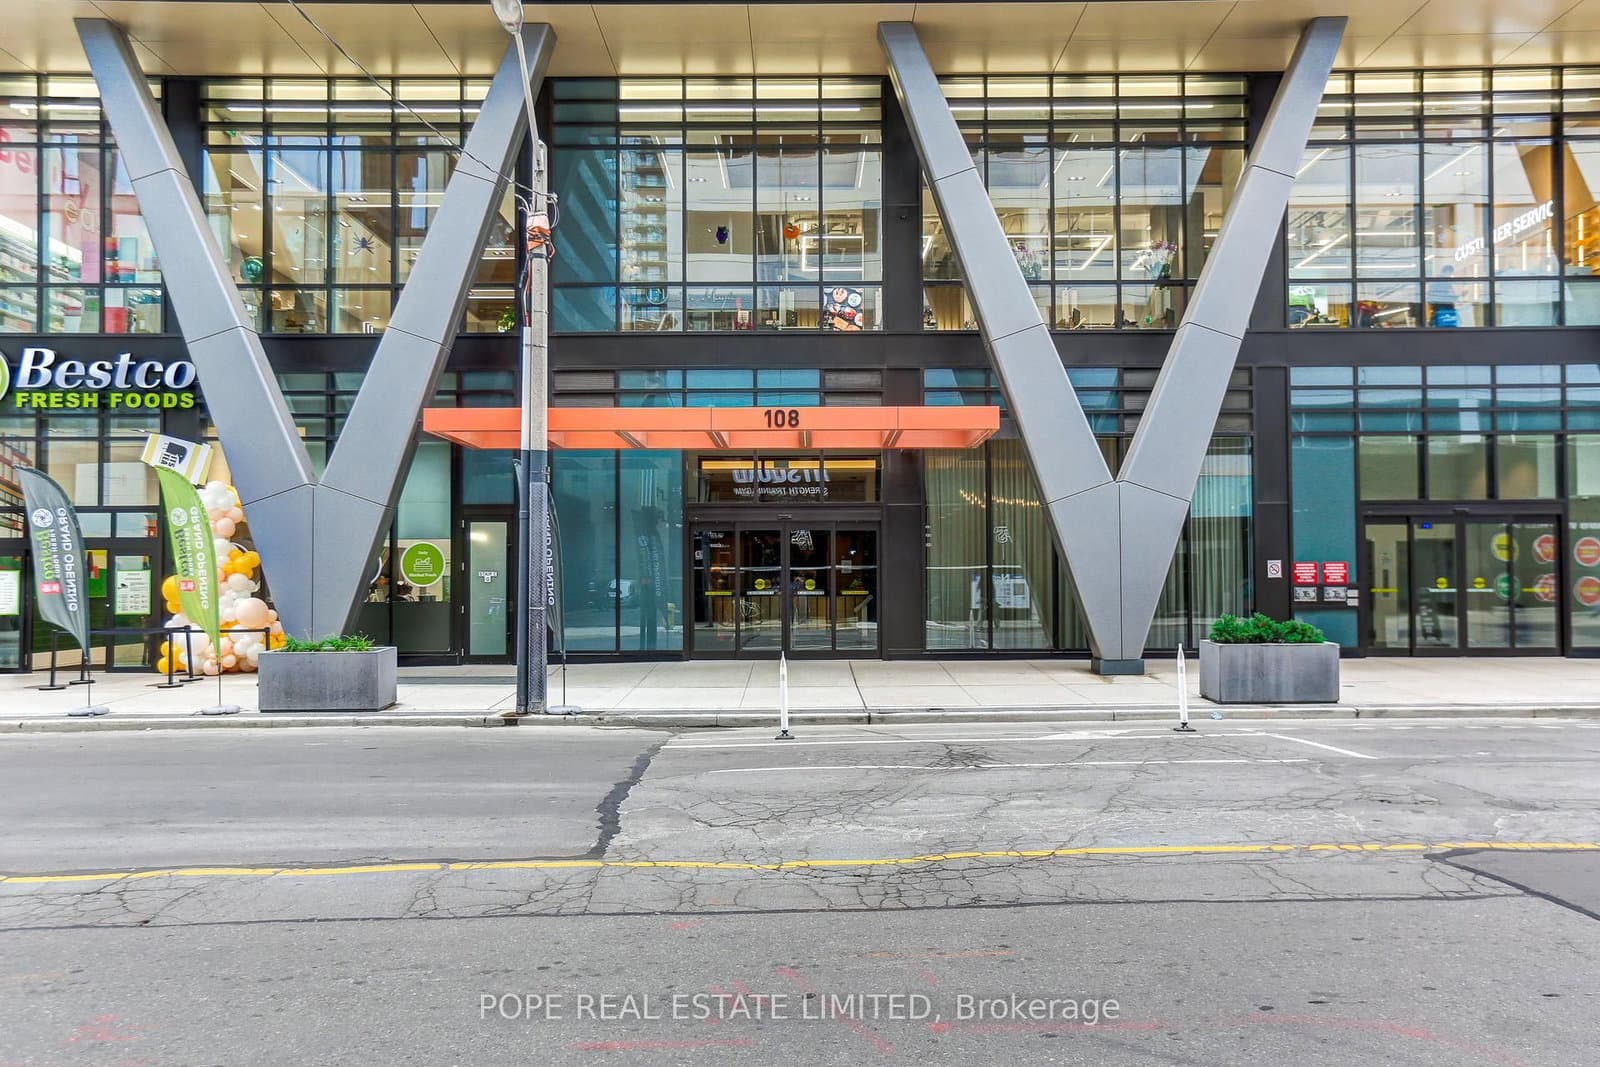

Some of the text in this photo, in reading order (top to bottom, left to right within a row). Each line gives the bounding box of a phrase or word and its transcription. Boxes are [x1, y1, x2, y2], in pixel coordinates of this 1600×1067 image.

[16, 347, 197, 389] Bestco
[15, 392, 195, 408] FRESH FOODS
[764, 408, 800, 428] 108
